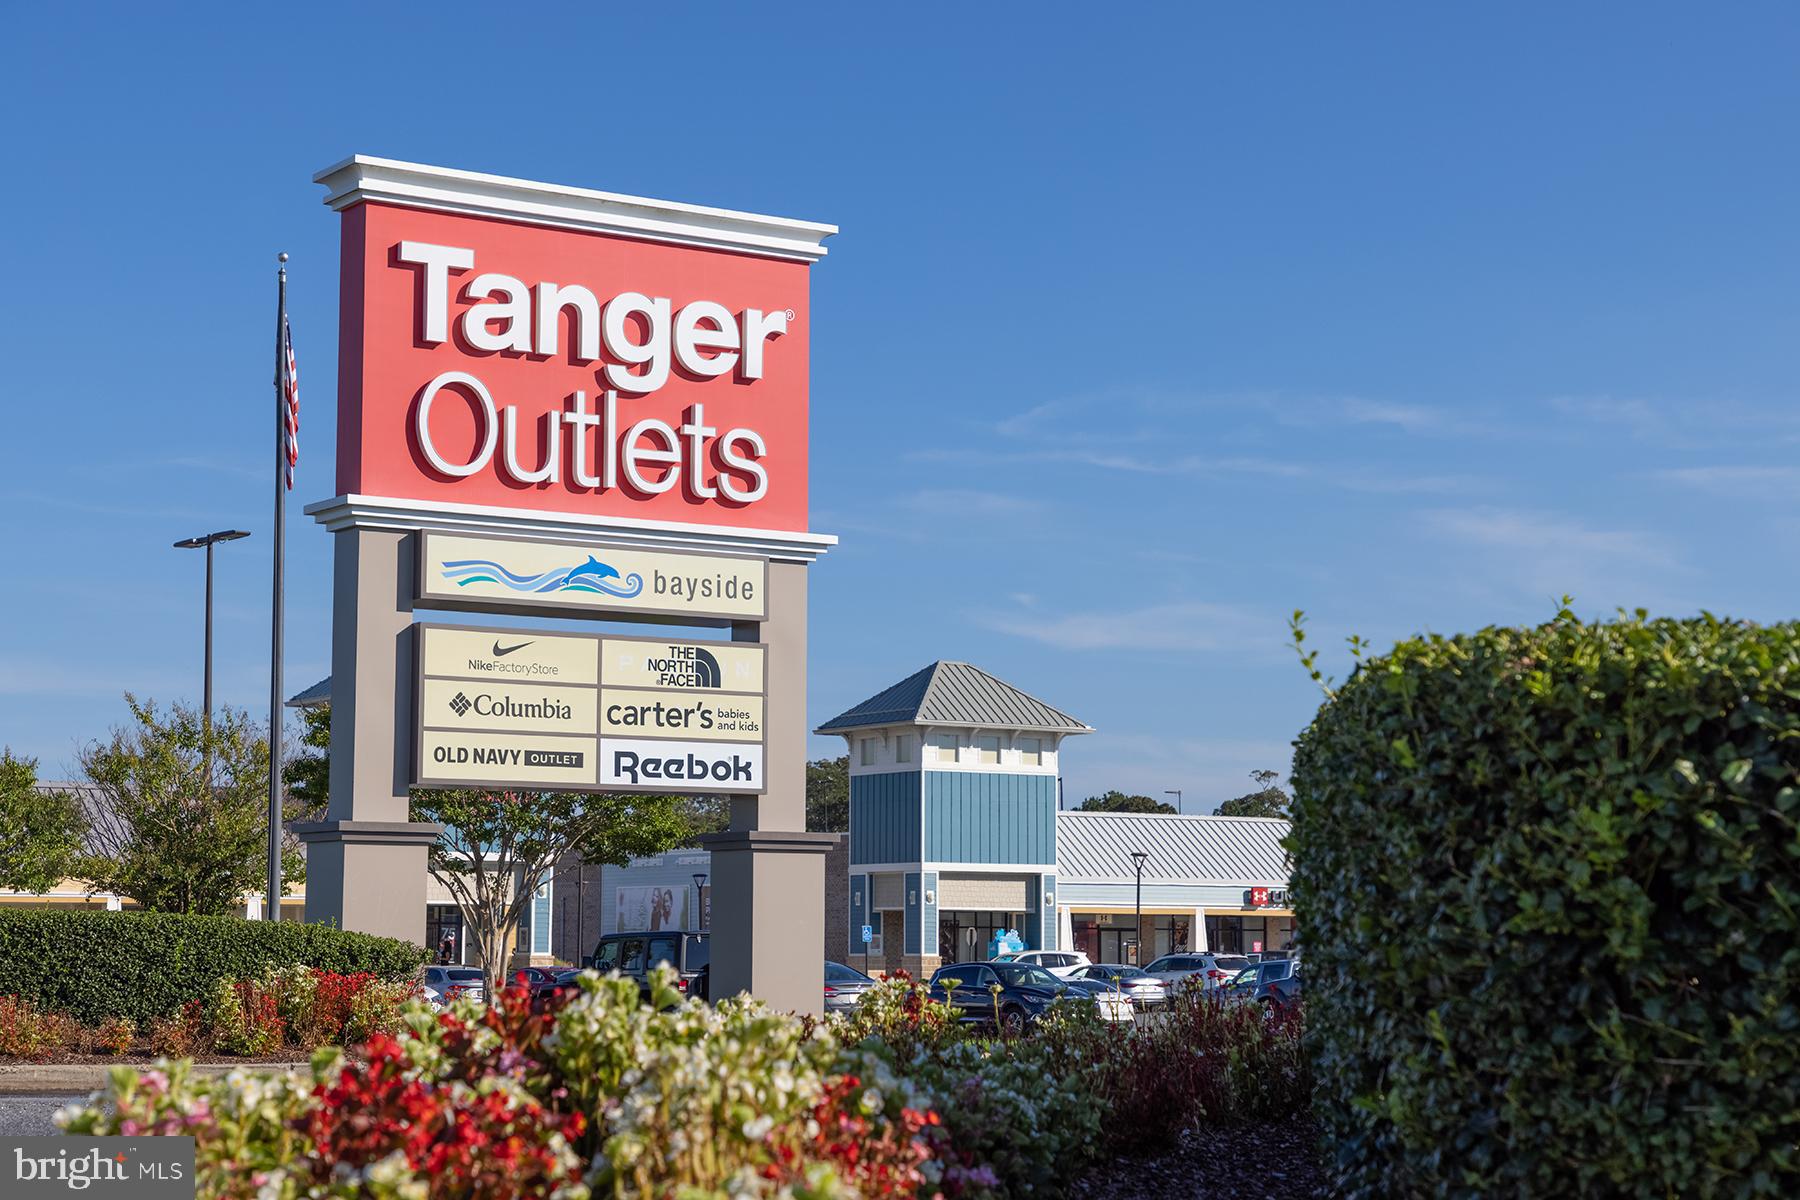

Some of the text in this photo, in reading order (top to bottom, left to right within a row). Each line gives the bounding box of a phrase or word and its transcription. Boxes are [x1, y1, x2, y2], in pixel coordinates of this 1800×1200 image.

[400, 240, 786, 393] Tanger
[418, 390, 769, 503] Outlets
[654, 570, 754, 602] bayside
[669, 646, 695, 660] THE
[647, 659, 695, 674] NORTH
[660, 673, 695, 687] FACE
[473, 694, 572, 720] Columbia
[606, 701, 714, 730] carter's
[717, 708, 750, 720] babies
[717, 721, 759, 732] and kids
[433, 746, 577, 766] OLD NAVY OUTLET
[614, 750, 752, 785] Reebok
